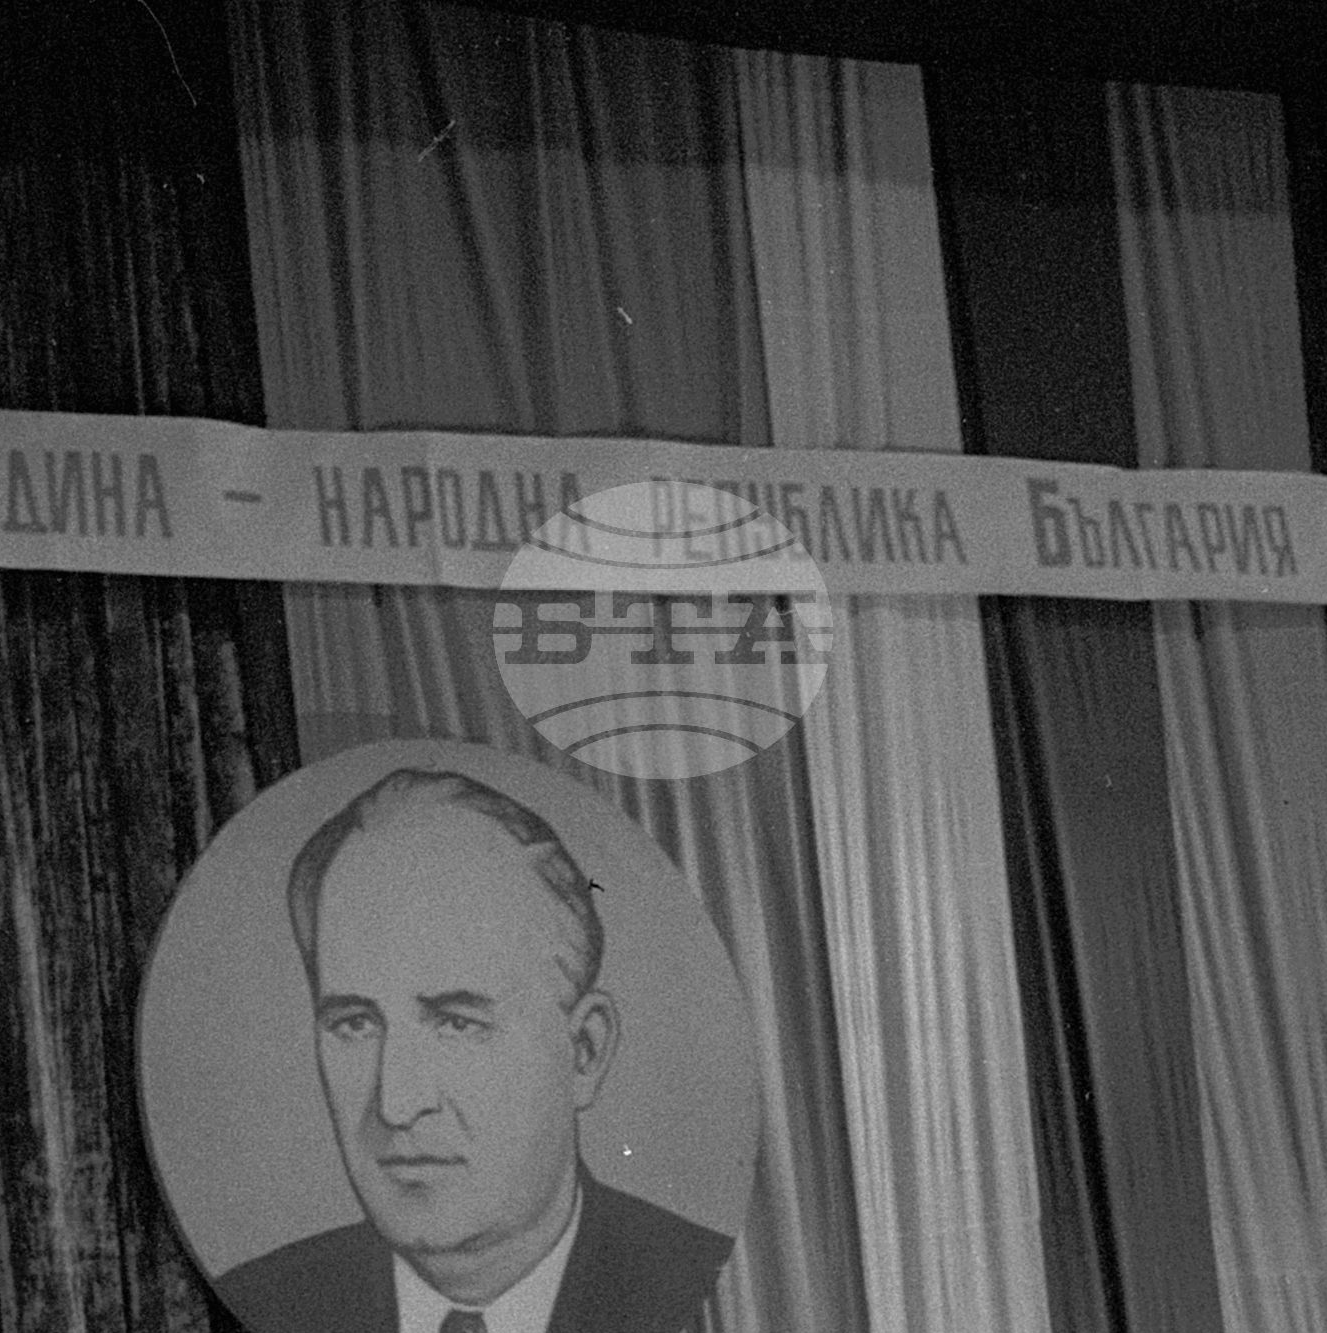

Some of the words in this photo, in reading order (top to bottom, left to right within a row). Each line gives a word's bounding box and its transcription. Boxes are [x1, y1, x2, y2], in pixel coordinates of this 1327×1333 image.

[313, 464, 593, 556] НАРОДНА
[648, 475, 970, 565] РЕПУБЛИКА
[1026, 476, 1299, 577] БЪЛГАРИЯ
